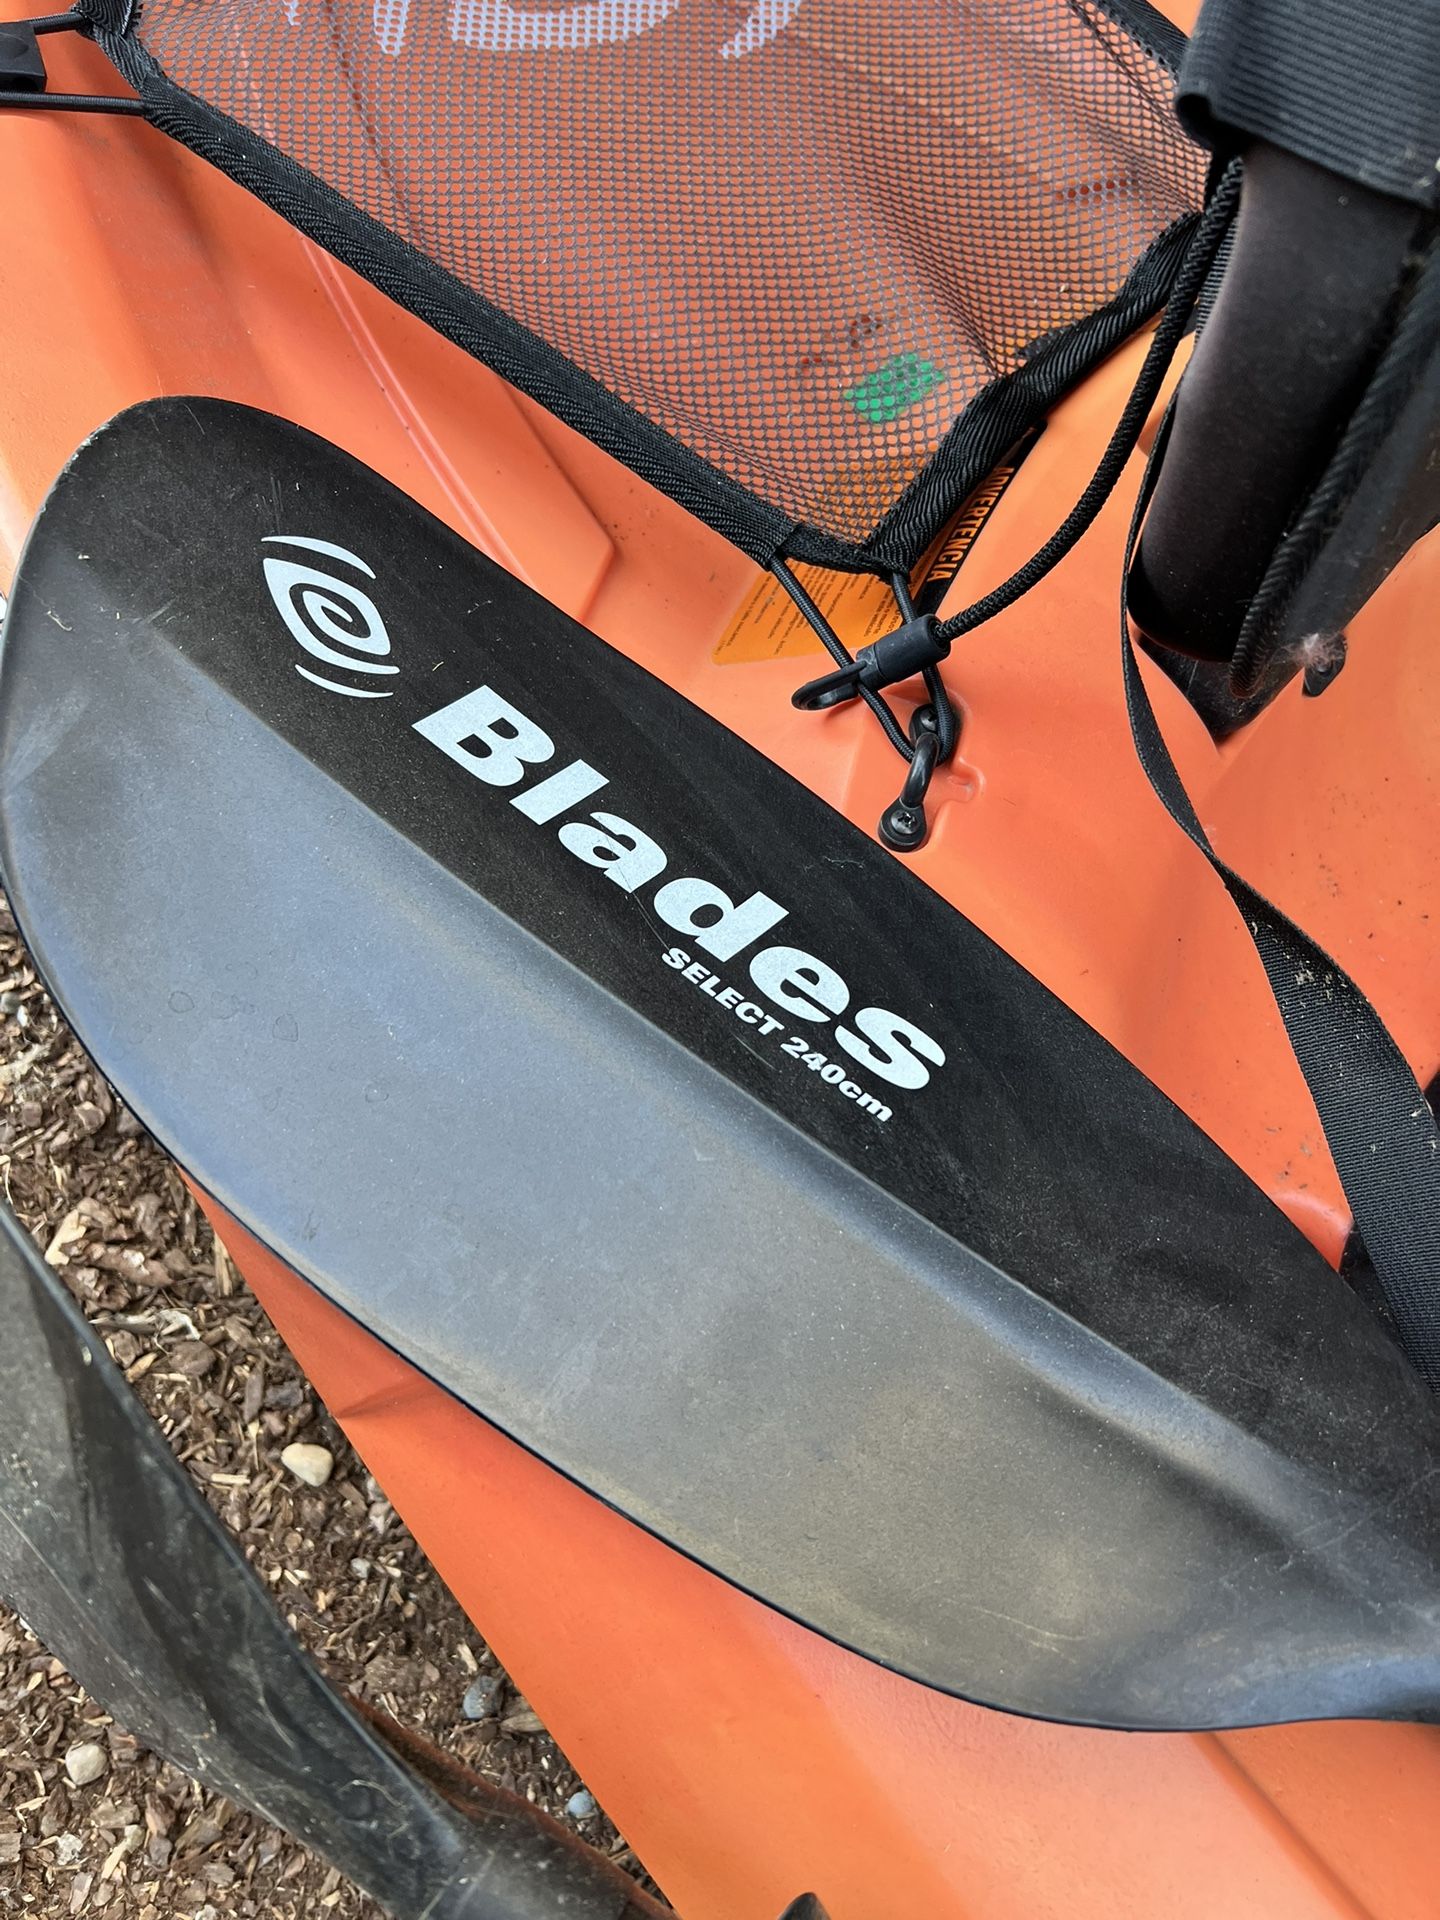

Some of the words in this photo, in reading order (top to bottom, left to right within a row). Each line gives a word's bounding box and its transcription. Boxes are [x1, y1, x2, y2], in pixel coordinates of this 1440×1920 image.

[926, 466, 1015, 582] ADVERTENCIA
[411, 684, 946, 1090] Blades
[661, 947, 784, 1037] SELECT
[780, 1036, 894, 1124] 240cm
